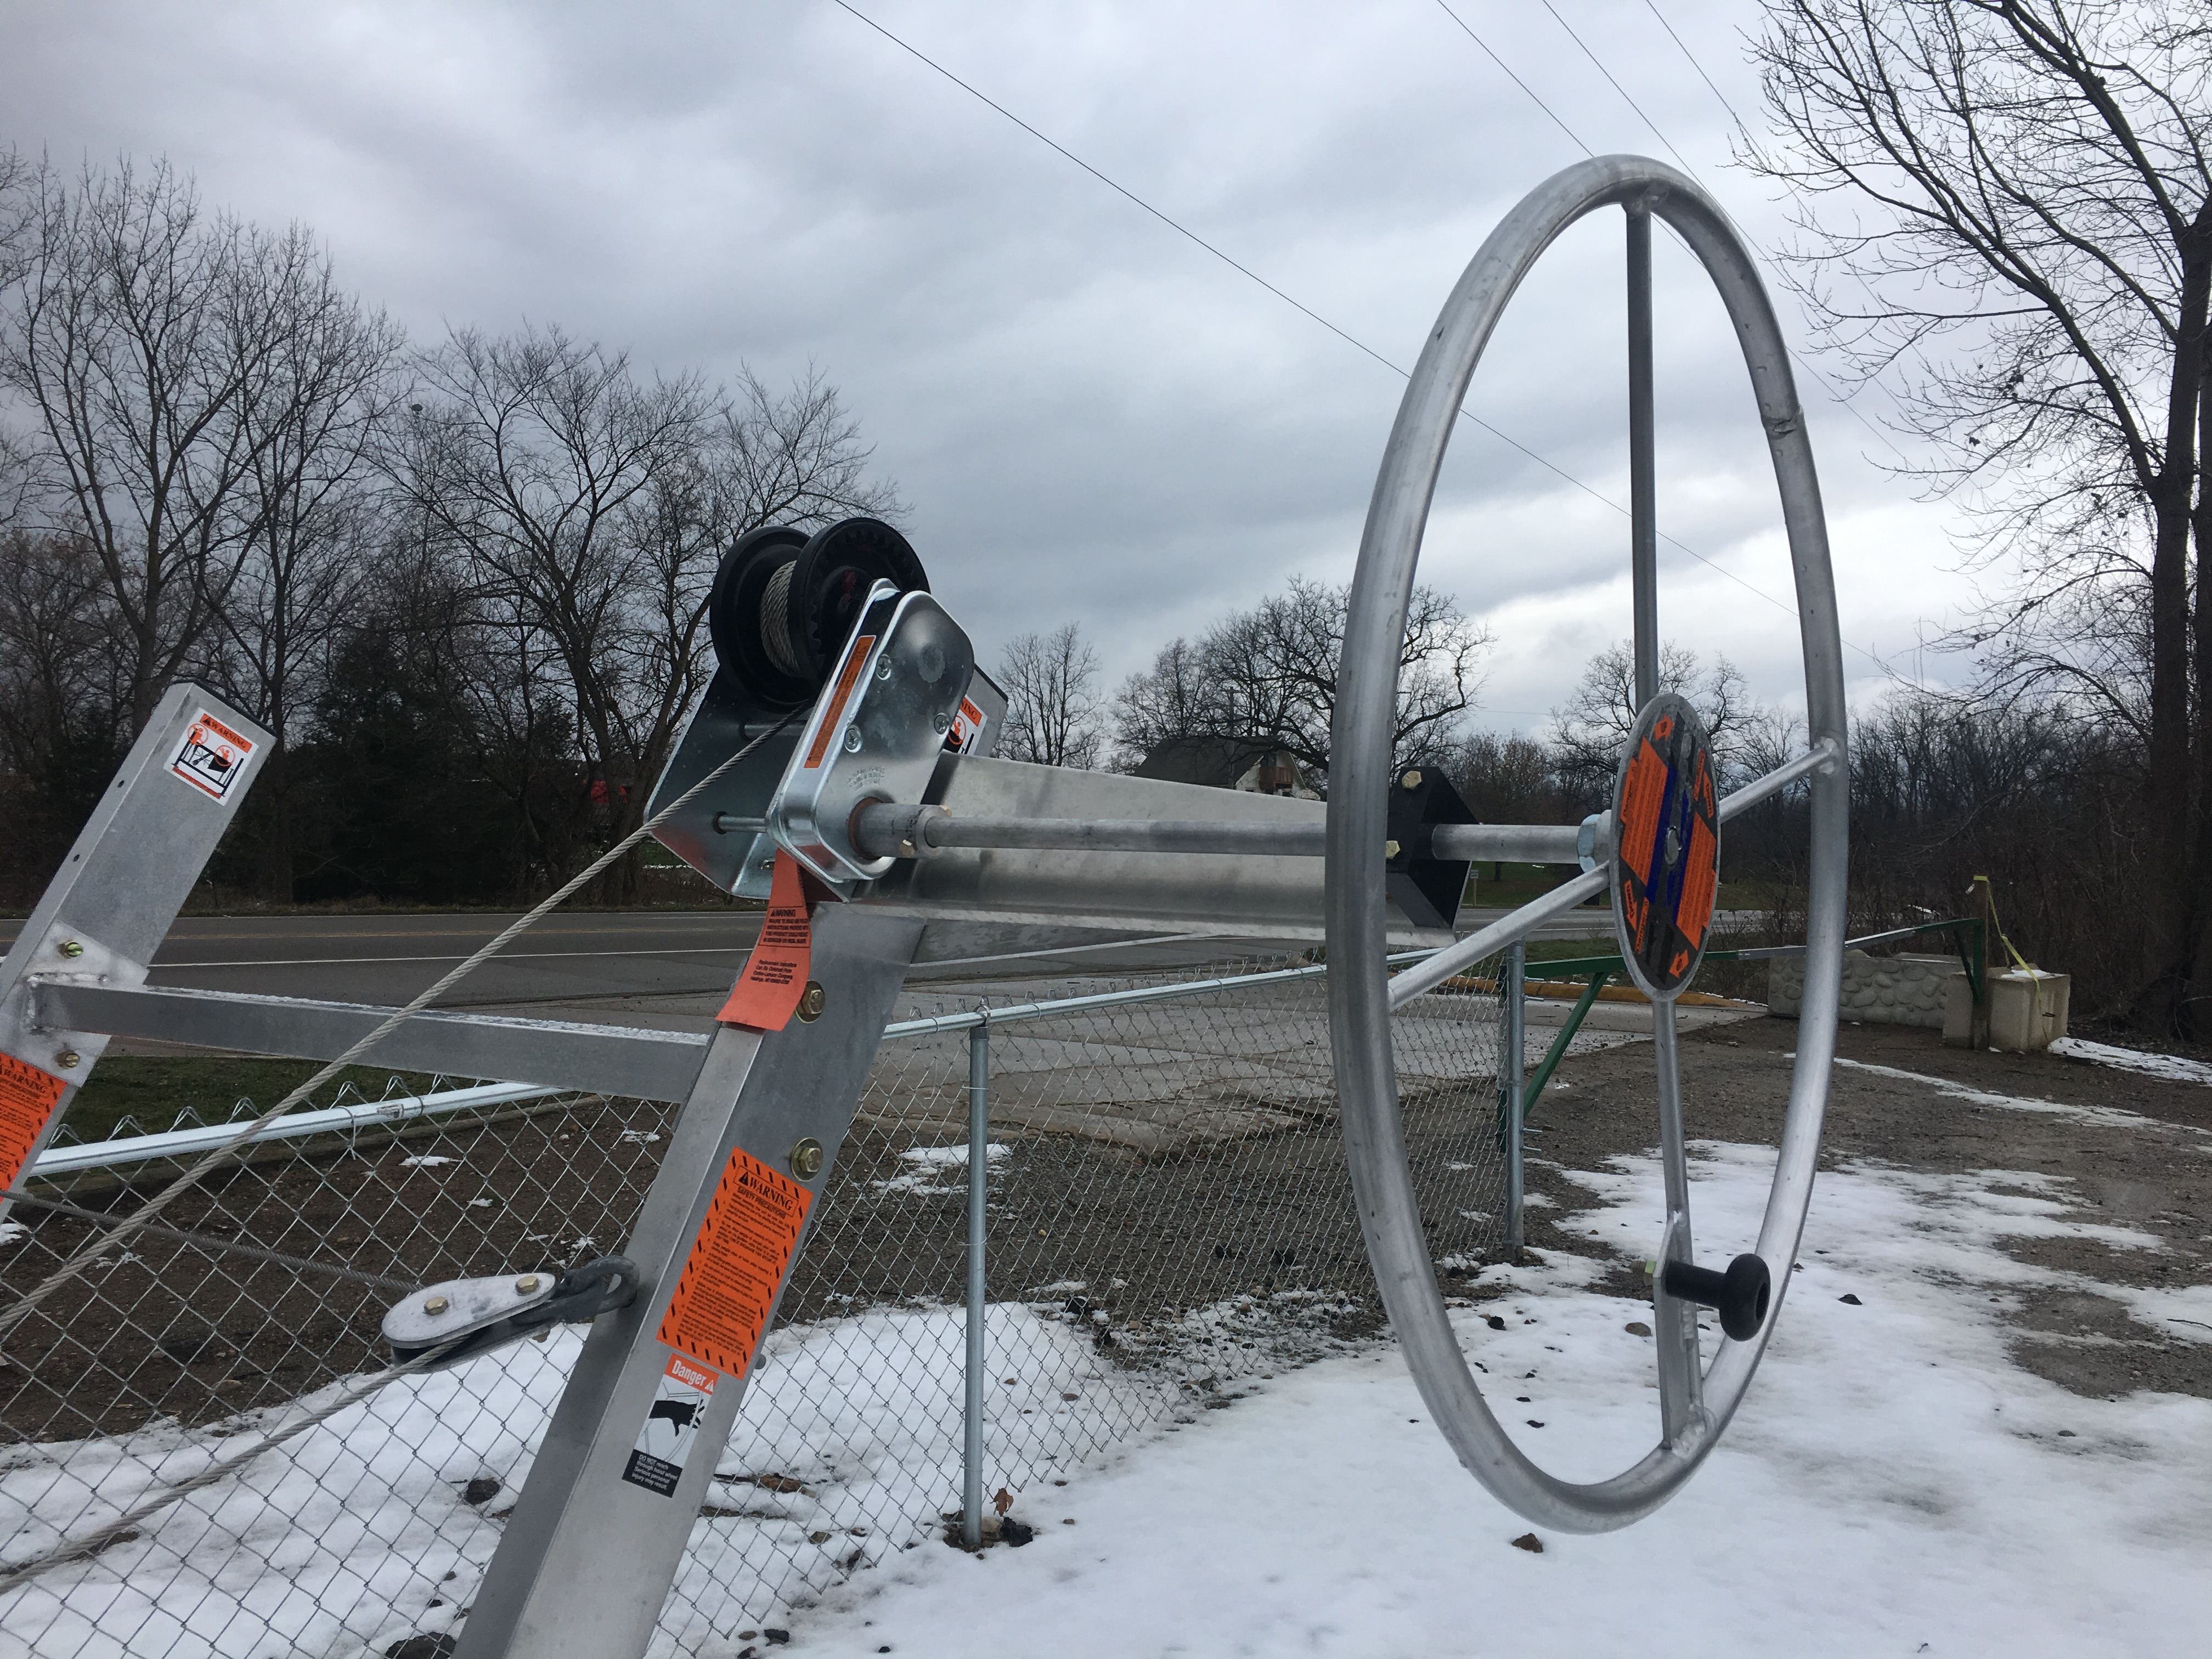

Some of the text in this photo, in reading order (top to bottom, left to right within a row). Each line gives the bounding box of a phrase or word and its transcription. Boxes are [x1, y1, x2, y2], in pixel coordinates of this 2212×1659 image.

[210, 723, 246, 748] WARNING
[737, 1186, 786, 1220] SAFETY PRECAUTIONS
[748, 1176, 793, 1211] WARNING
[671, 1359, 707, 1386] Danger
[634, 1466, 670, 1484] Serious personal
[636, 1460, 653, 1471] through
[644, 1478, 654, 1486] may
